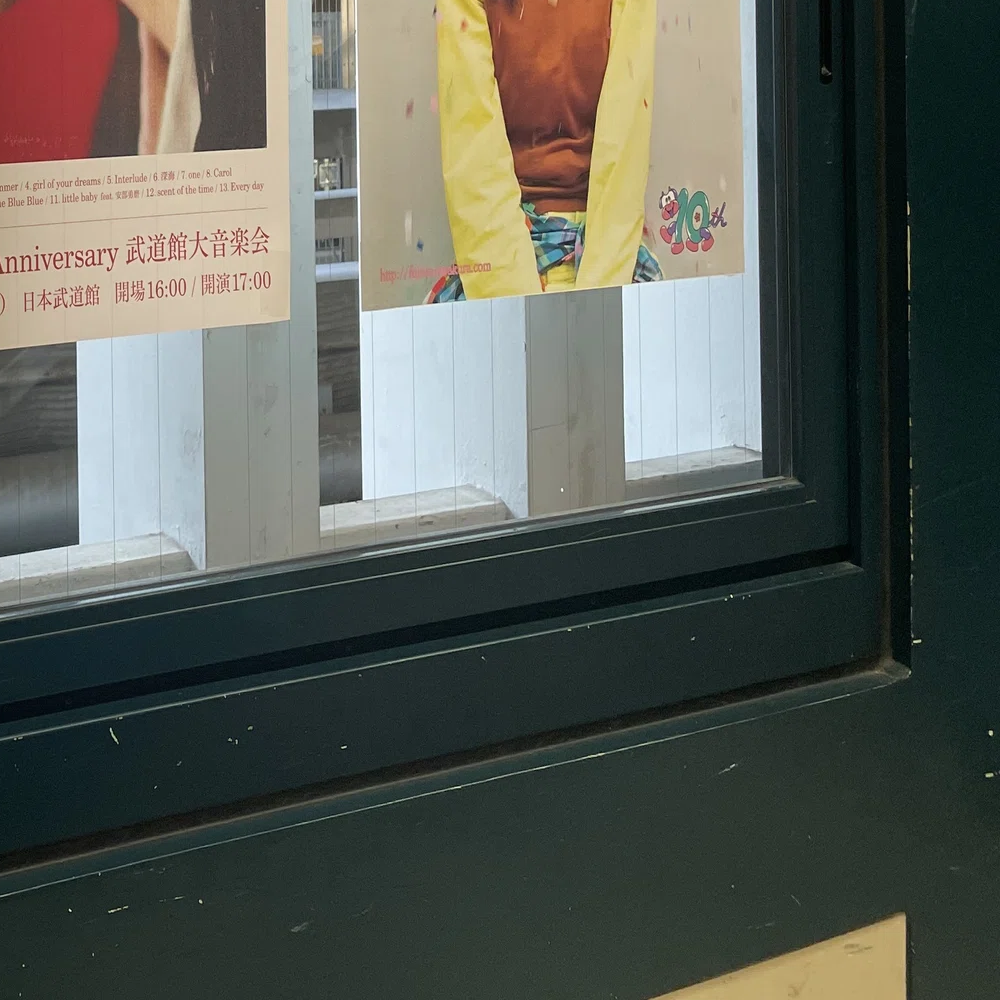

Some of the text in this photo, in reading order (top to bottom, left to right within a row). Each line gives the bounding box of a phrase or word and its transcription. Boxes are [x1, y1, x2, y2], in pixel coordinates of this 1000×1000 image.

[8, 197, 25, 207] Blue
[26, 196, 44, 206] Blue
[62, 192, 79, 203] little
[81, 191, 98, 205] baby
[100, 191, 113, 201] feat.
[157, 186, 176, 197] scent
[177, 185, 185, 195] of
[185, 185, 197, 195] the
[198, 184, 214, 194] time
[231, 182, 250, 193] Every
[252, 181, 265, 192] day
[33, 178, 45, 191] girl
[47, 178, 55, 189] of
[55, 179, 73, 190] your
[74, 176, 101, 187] dreams
[115, 172, 147, 185] Interlude
[188, 171, 200, 179] one
[213, 167, 232, 178] Carol
[125, 226, 270, 266] 武道館大音楽会
[23, 284, 100, 313] 日本武道館
[115, 278, 187, 304] 開場16:00
[201, 270, 271, 296] 開演17:00
